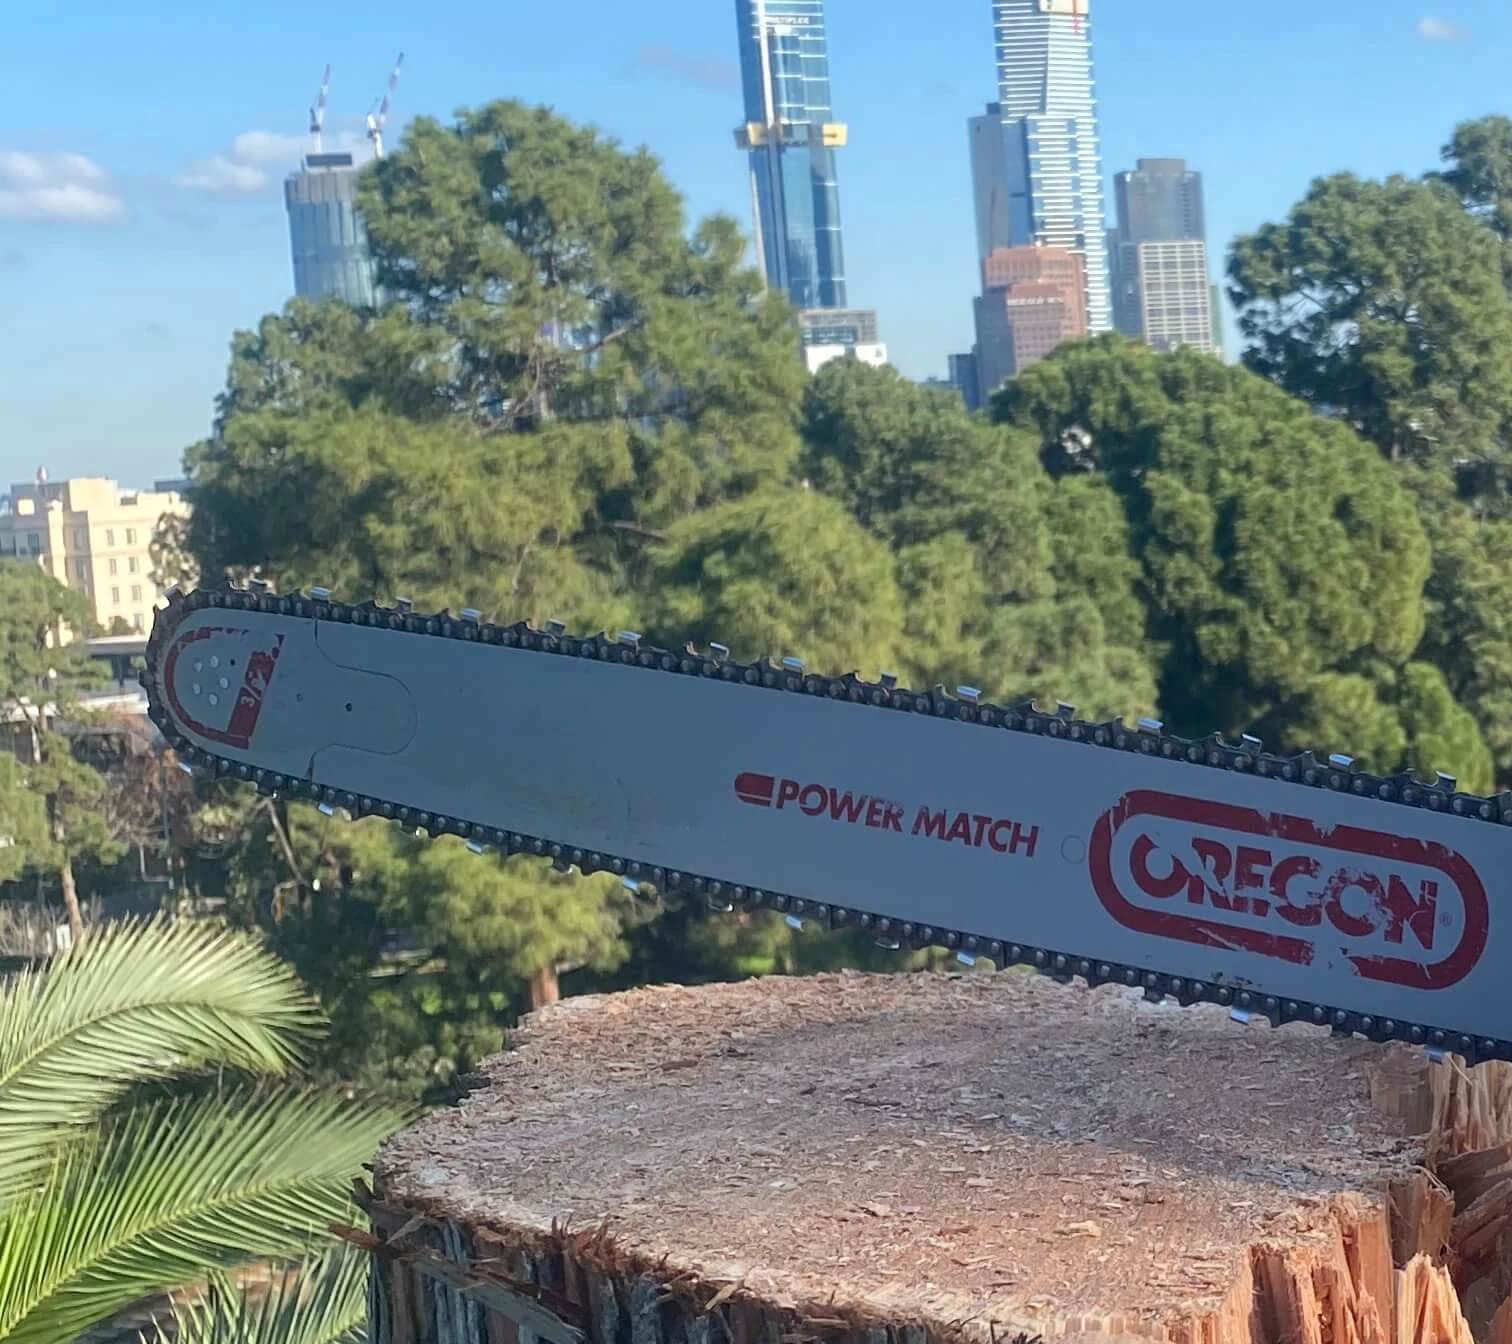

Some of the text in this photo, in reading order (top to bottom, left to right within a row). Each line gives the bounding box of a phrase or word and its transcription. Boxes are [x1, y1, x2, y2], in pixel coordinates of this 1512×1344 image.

[776, 778, 1039, 857] POWER MATCH
[1129, 833, 1437, 950] OREGON
